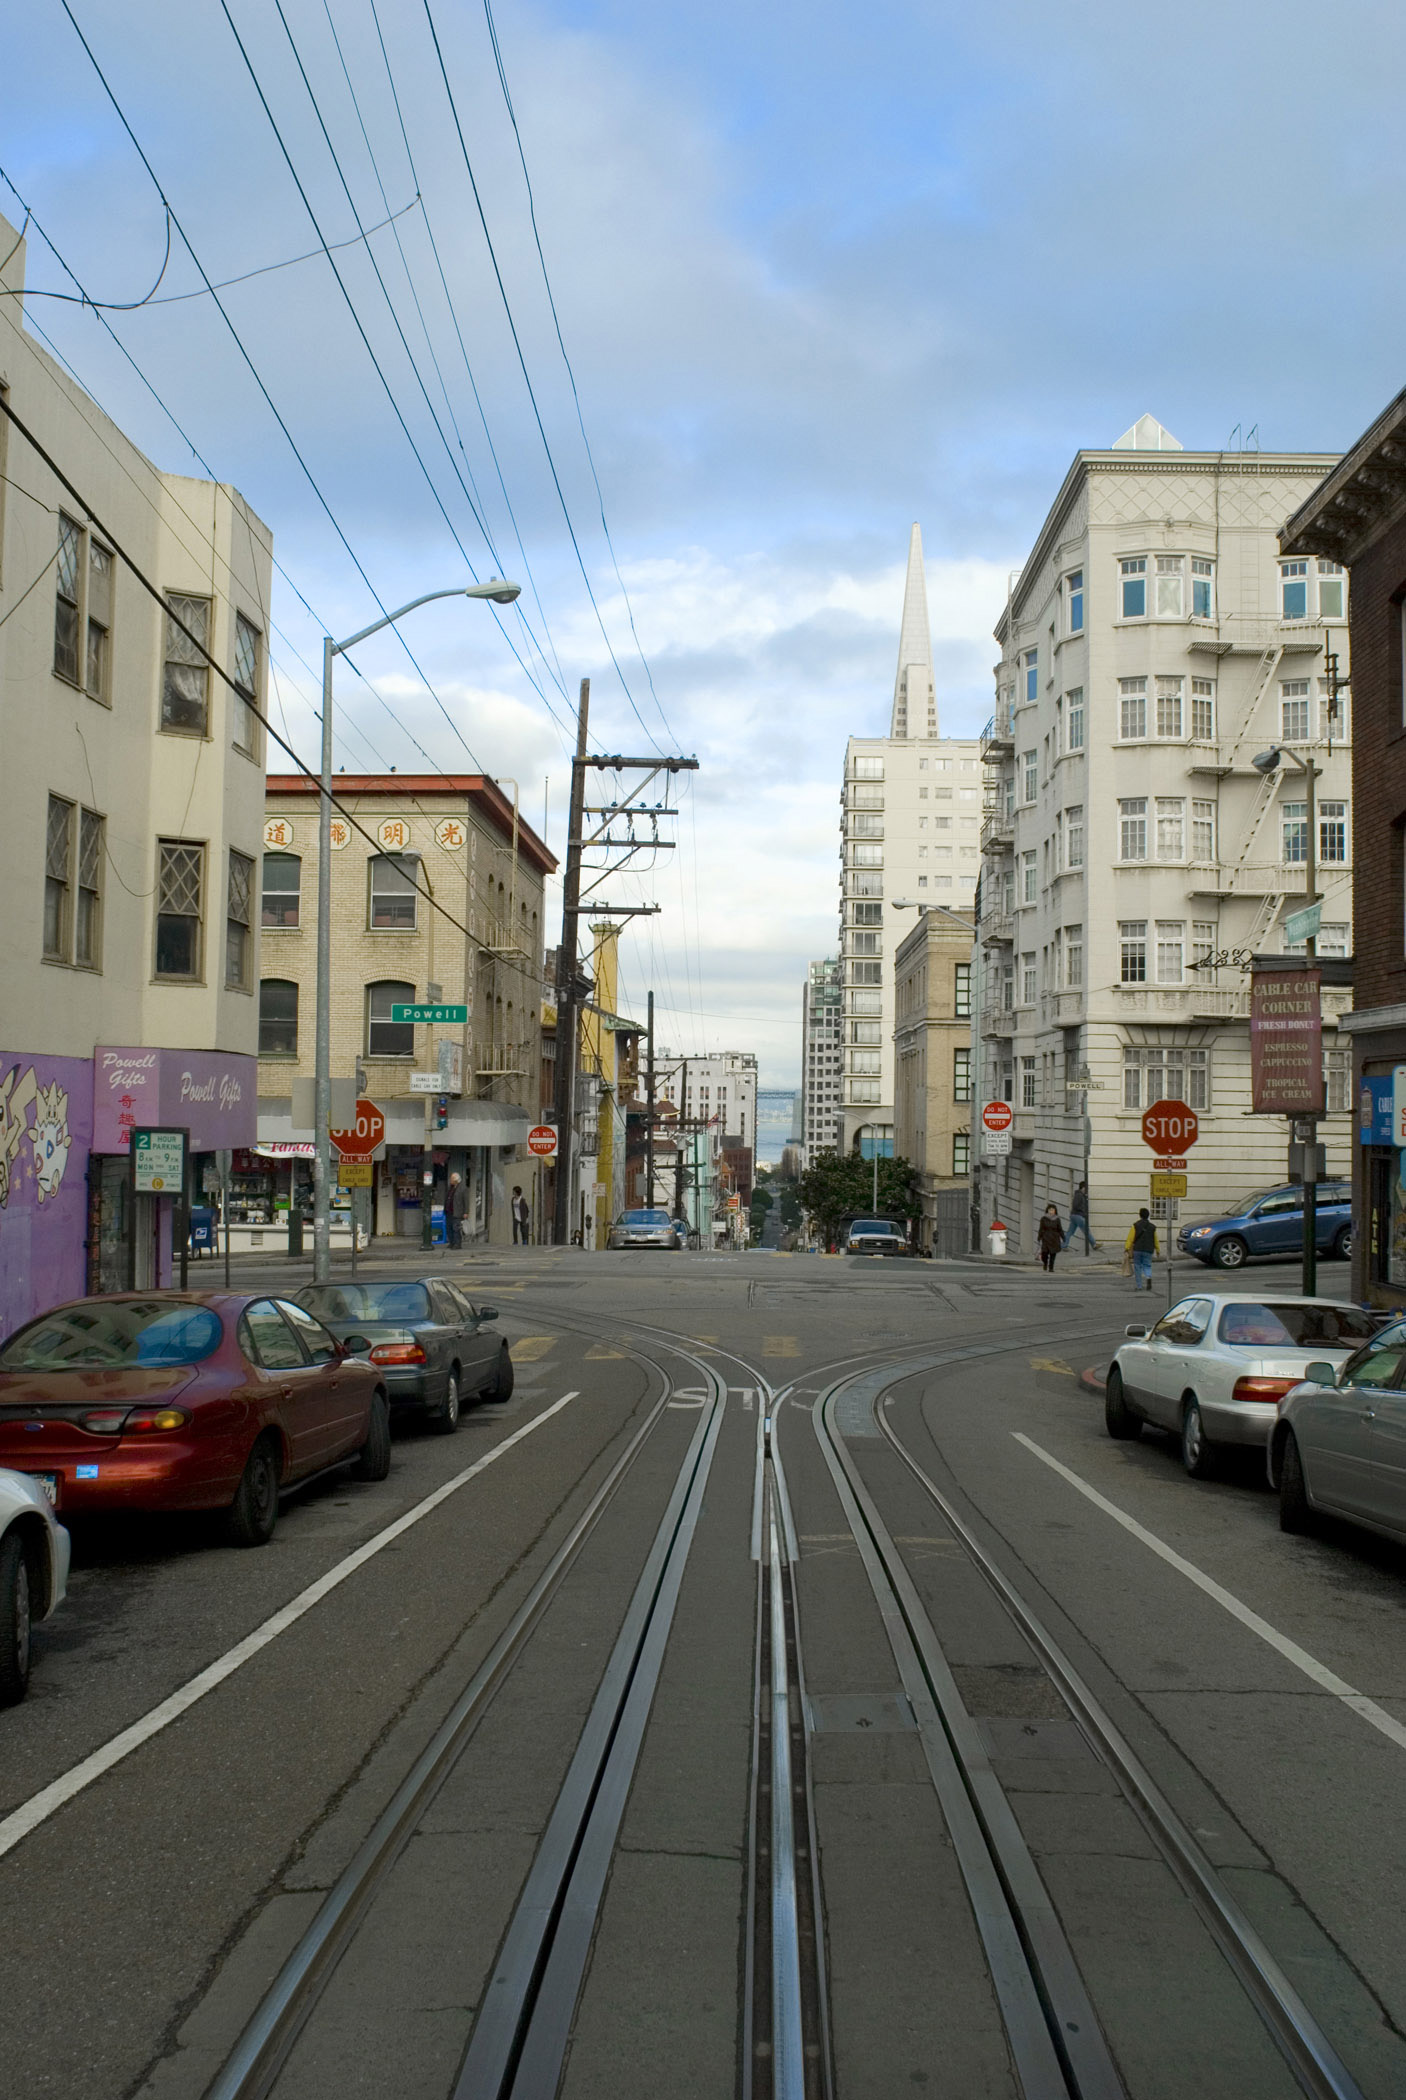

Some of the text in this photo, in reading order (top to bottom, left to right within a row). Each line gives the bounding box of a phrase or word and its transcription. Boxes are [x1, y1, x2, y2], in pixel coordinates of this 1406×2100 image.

[266, 823, 288, 846] 道
[383, 822, 404, 846] 明
[441, 823, 463, 846] 光
[1253, 981, 1318, 997] CABLE CAR
[403, 1008, 456, 1019] Powell
[1261, 1000, 1312, 1014] CORNER
[1257, 1020, 1314, 1030] FRESH DONUT
[1264, 1043, 1308, 1052] ESPRESSO
[102, 1052, 156, 1069] Powell
[1260, 1058, 1313, 1067] CAPPUCCINO
[109, 1069, 146, 1090] Gifts
[1266, 1078, 1308, 1087] TROPICAL
[180, 1071, 242, 1111] Powell Gifts
[1262, 1089, 1312, 1098] ICE CREAM
[1145, 1117, 1196, 1138] STOP
[139, 1135, 149, 1148] 2
[138, 1152, 145, 1161] 8
[164, 1153, 170, 1162] 9
